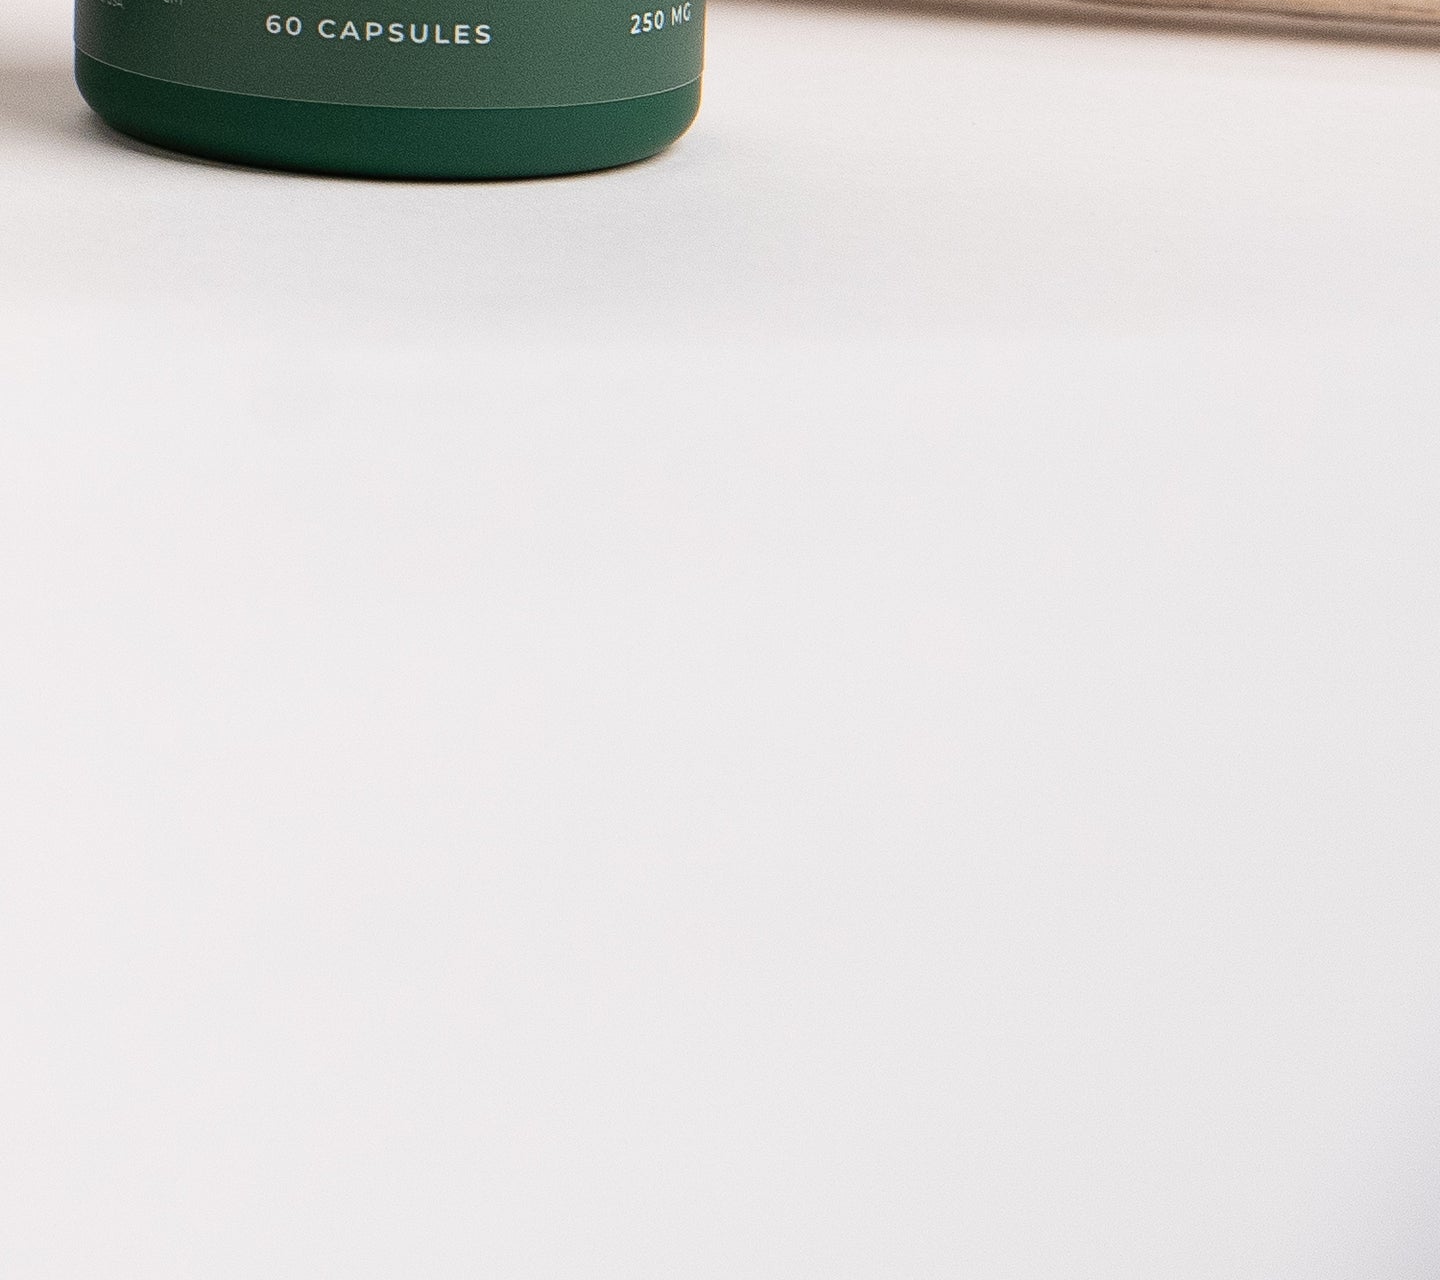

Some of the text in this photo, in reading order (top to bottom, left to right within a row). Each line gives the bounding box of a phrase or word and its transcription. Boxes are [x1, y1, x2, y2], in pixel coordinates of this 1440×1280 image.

[264, 13, 493, 46] 60 CAPSULES
[629, 2, 692, 36] 250 MG
